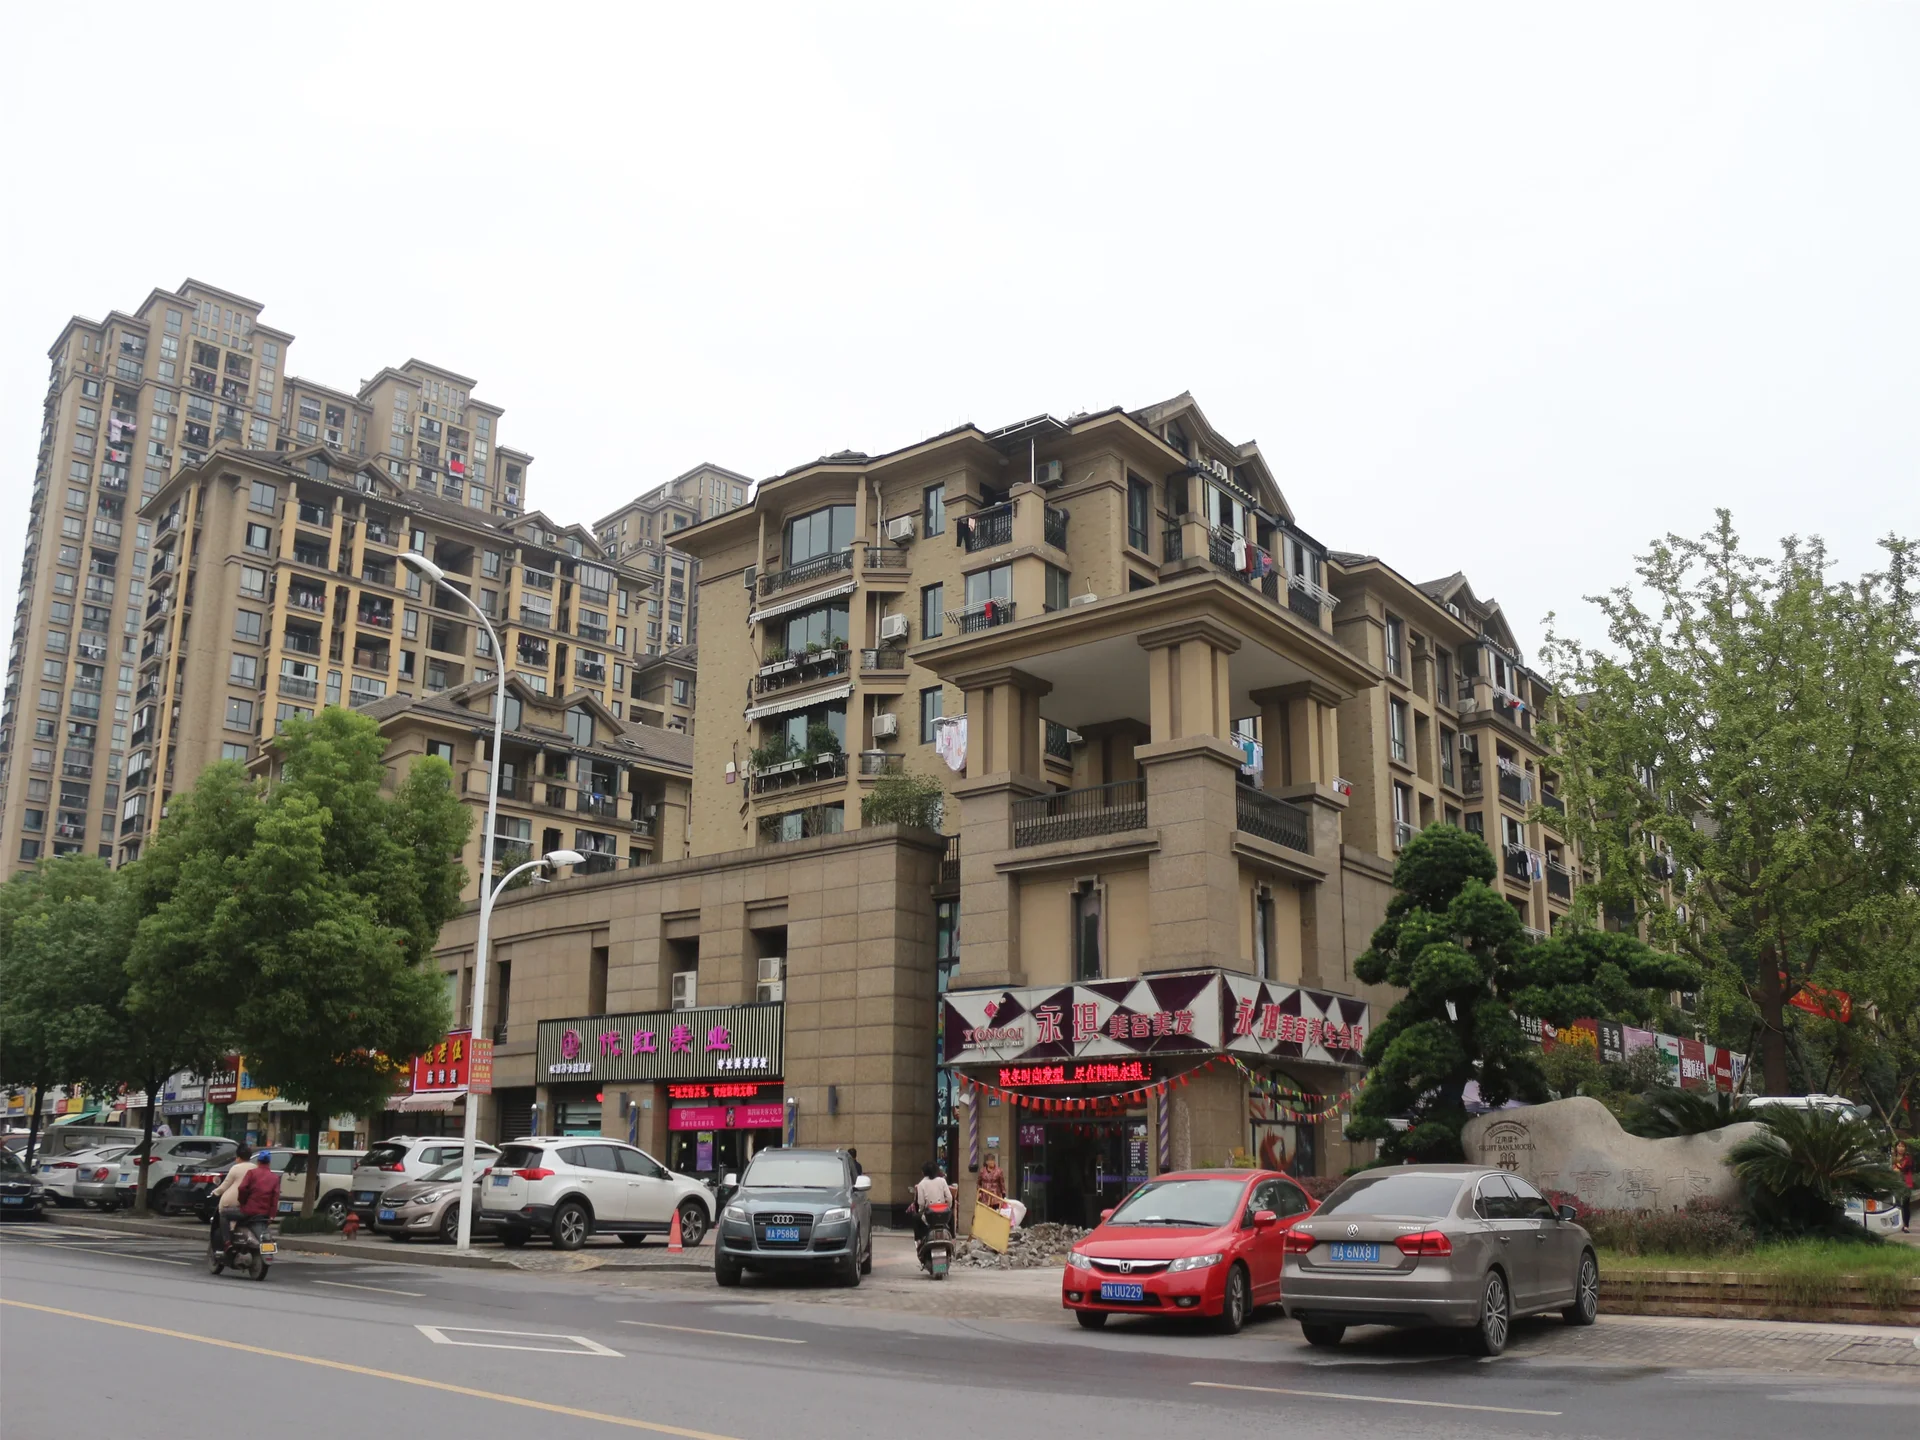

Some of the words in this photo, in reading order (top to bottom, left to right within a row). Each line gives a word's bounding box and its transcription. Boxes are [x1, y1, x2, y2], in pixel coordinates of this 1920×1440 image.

[599, 1024, 734, 1057] 代红美业
[962, 1026, 1024, 1042] YONGQI
[1036, 1001, 1195, 1044] 永琪美容美发
[1233, 997, 1365, 1052] 永琪美容养生会所
